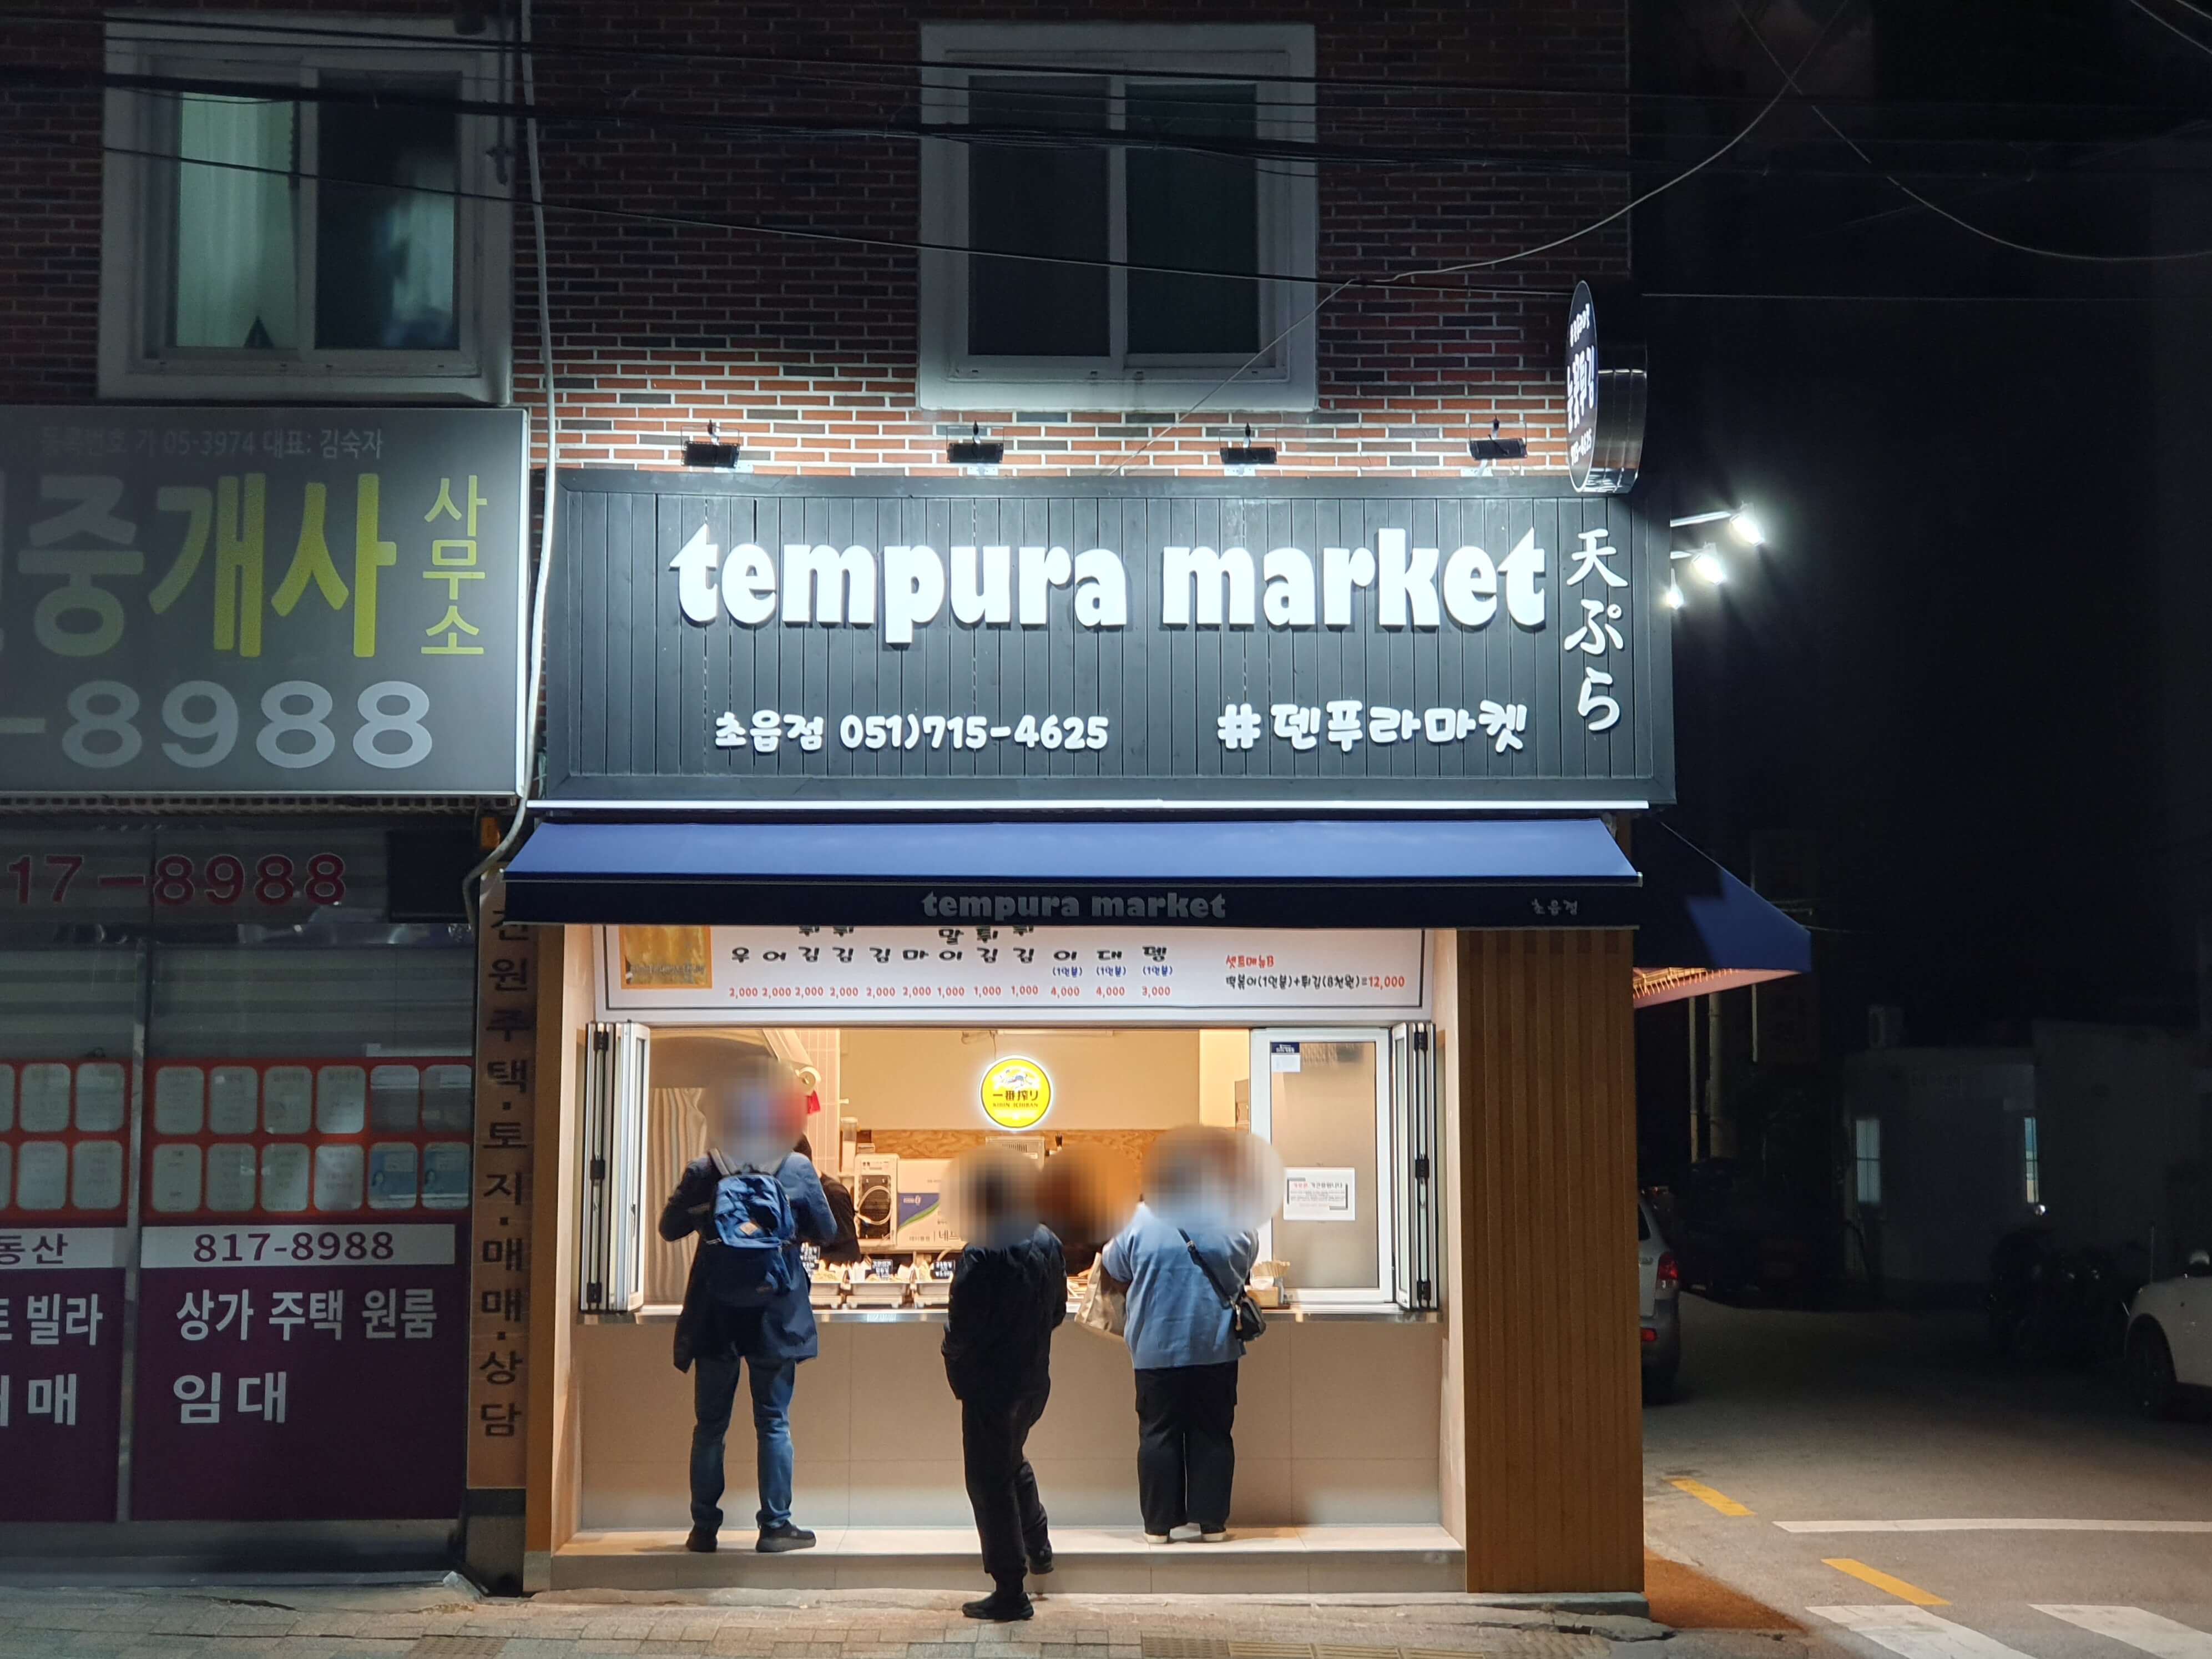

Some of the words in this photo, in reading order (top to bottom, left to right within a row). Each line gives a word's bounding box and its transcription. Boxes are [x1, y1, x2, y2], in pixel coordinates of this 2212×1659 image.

[163, 429, 254, 456] 05-3974
[262, 426, 312, 459] 대표:
[320, 428, 384, 460] 김숙자
[0, 473, 397, 658] 중개사
[421, 475, 488, 655] 사무소
[669, 523, 1128, 648] tempura
[1162, 526, 1547, 629] market
[1564, 528, 1629, 731] 天ぷら
[715, 710, 824, 753] 초읍점
[840, 714, 1109, 750] 051)715-4625
[921, 891, 1080, 921] tempura
[1091, 892, 1226, 919] market
[993, 1090, 1039, 1102] 一番搾り
[193, 1231, 395, 1263] 817-8988
[27, 1293, 104, 1347] 빌라
[176, 1289, 254, 1341] 상가
[269, 1289, 344, 1341] 주택
[361, 1288, 437, 1339] 원룸
[0, 1373, 78, 1426] 매
